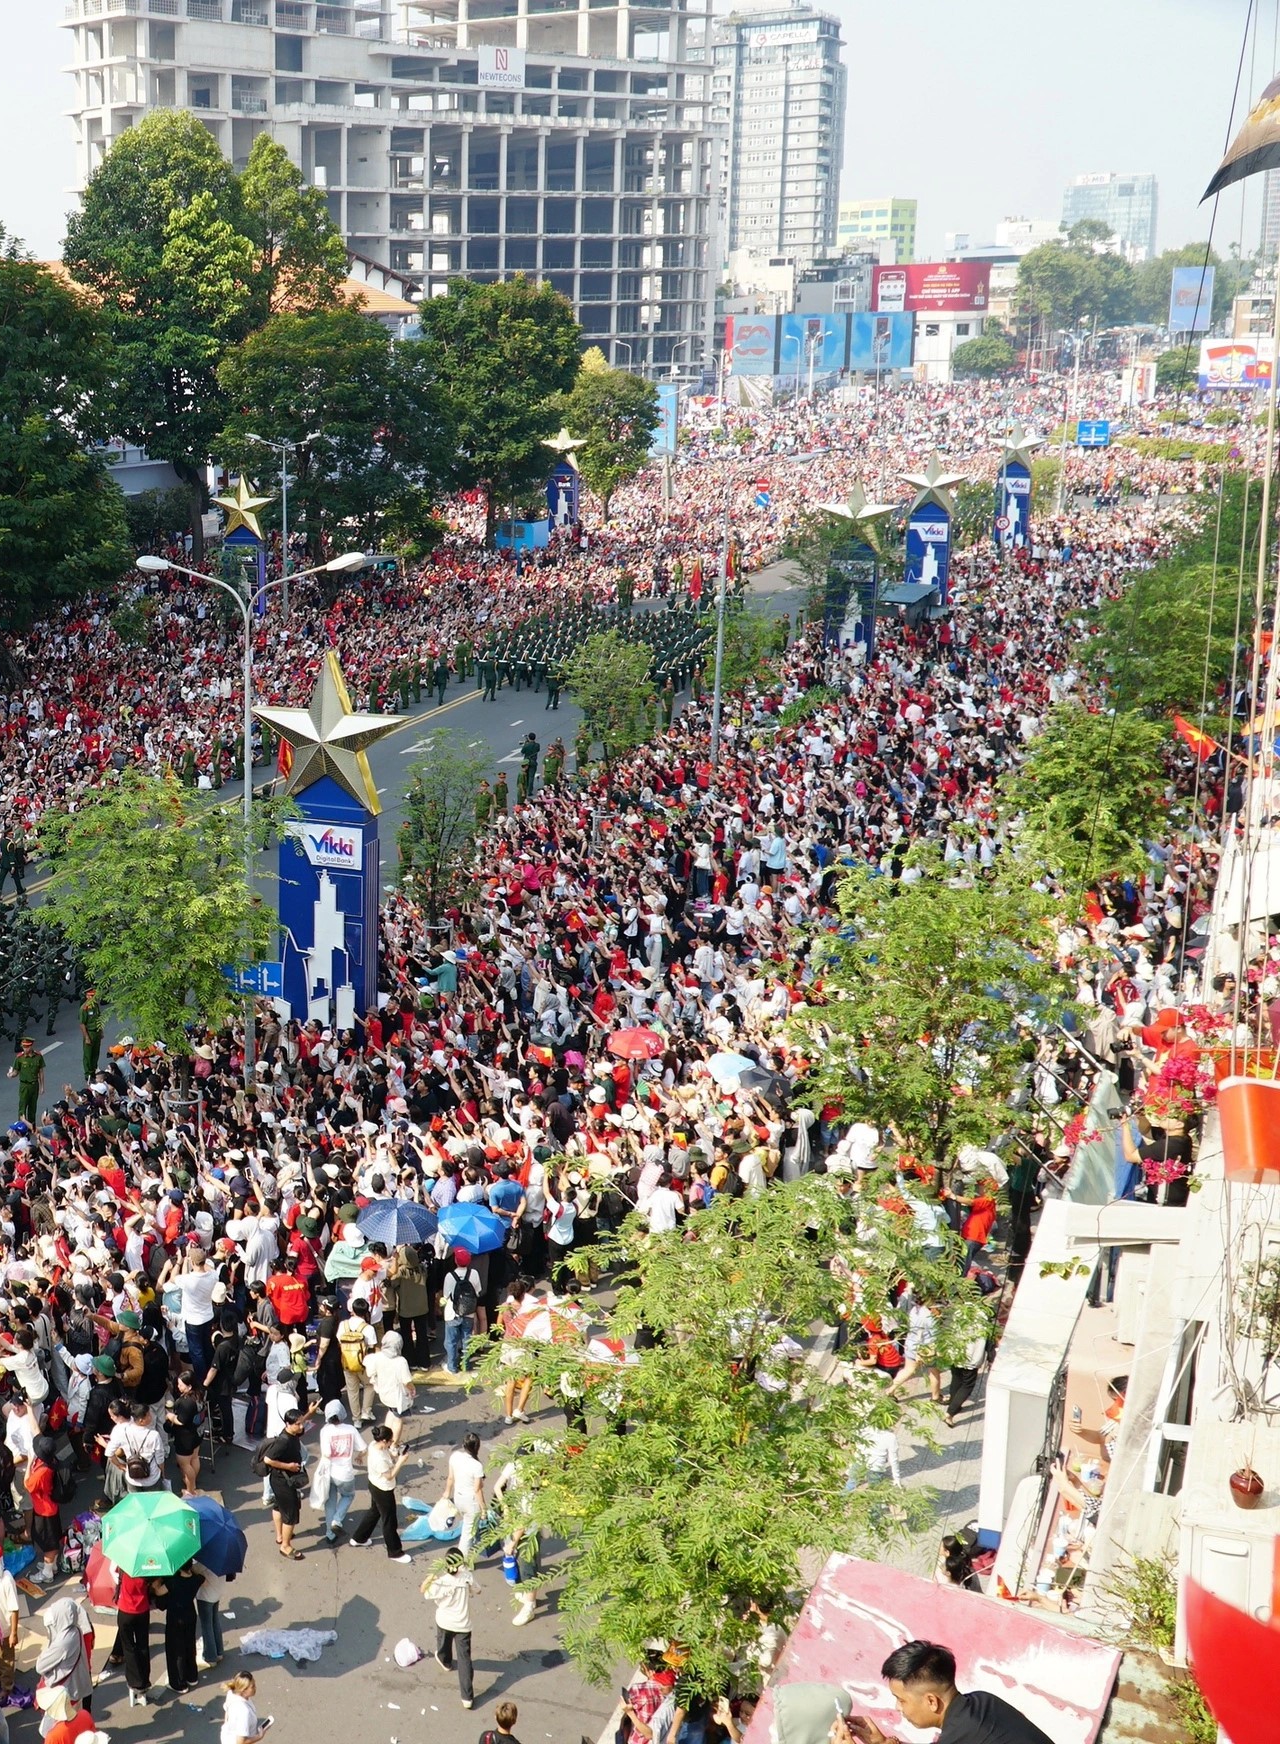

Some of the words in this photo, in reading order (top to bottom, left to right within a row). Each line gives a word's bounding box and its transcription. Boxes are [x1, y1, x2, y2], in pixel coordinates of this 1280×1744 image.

[770, 30, 809, 40] CAPELLA
[479, 72, 522, 83] NEWTECONS
[922, 524, 943, 535] Vikki
[308, 828, 354, 856] Vikki
